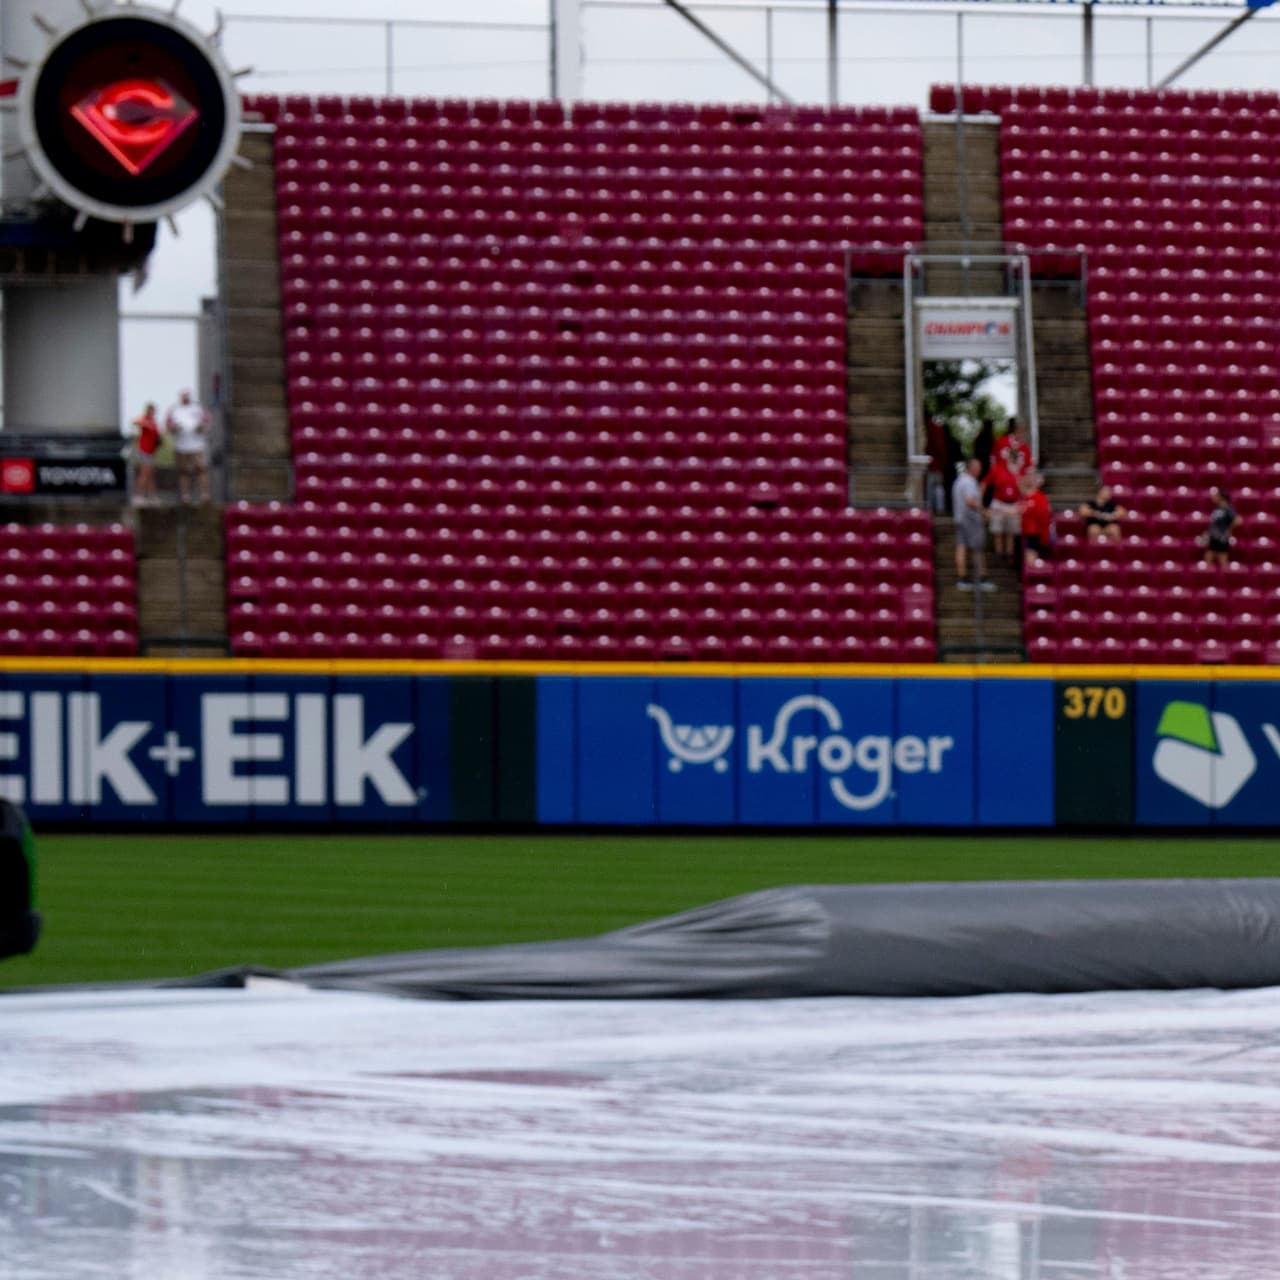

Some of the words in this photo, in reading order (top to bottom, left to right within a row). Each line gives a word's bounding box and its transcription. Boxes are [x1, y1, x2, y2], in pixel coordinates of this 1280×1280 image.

[39, 466, 117, 486] TOYOTA
[1063, 686, 1127, 719] 370
[0, 692, 418, 805] lk+Elk
[747, 695, 953, 810] Kroger
